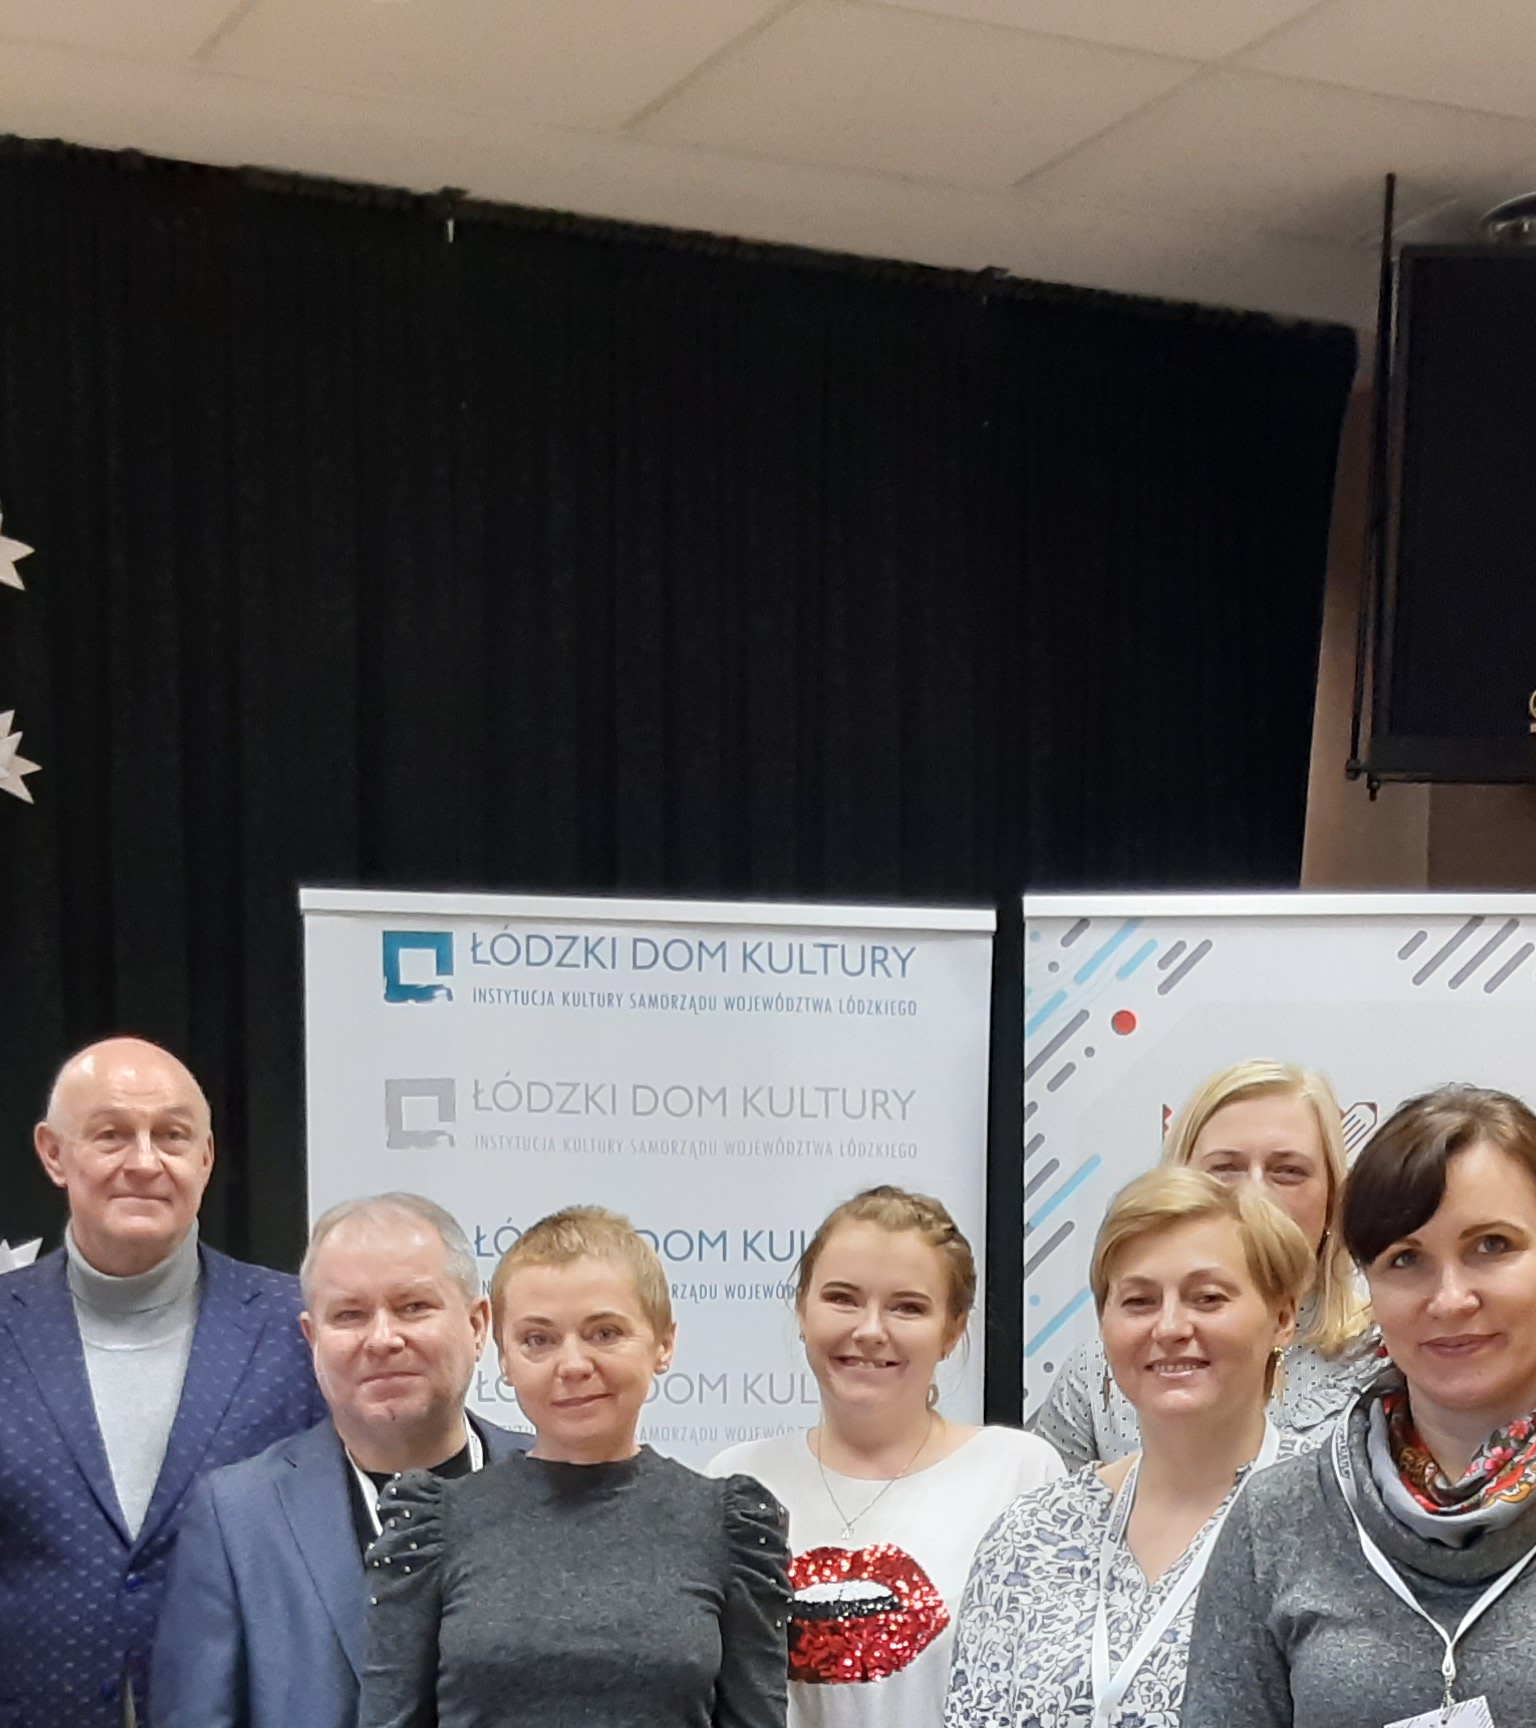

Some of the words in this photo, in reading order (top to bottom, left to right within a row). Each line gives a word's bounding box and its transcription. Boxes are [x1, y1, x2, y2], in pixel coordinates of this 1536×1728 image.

[470, 924, 617, 970] ŁÓDZKI
[632, 937, 727, 972] DOM
[742, 940, 917, 978] KULTURY
[472, 986, 556, 1007] INSTYTUCJA
[561, 990, 625, 1008] KULTURY
[629, 992, 718, 1015] SAMORZĄDU
[724, 991, 833, 1014] WOJEWÓDZTWA
[472, 1071, 617, 1116] ŁÓDZKI
[632, 1084, 727, 1118] DOM
[742, 1085, 917, 1121] KULTURY
[474, 1134, 556, 1153] INSTYTUCJA
[563, 1136, 625, 1154] KULTURY
[630, 1138, 718, 1161] SAMORZĄDU
[724, 1136, 834, 1158] WOJEWÓDZTWA
[671, 1283, 718, 1304] RZĄDU
[638, 1426, 718, 1446] AMORZĄDU
